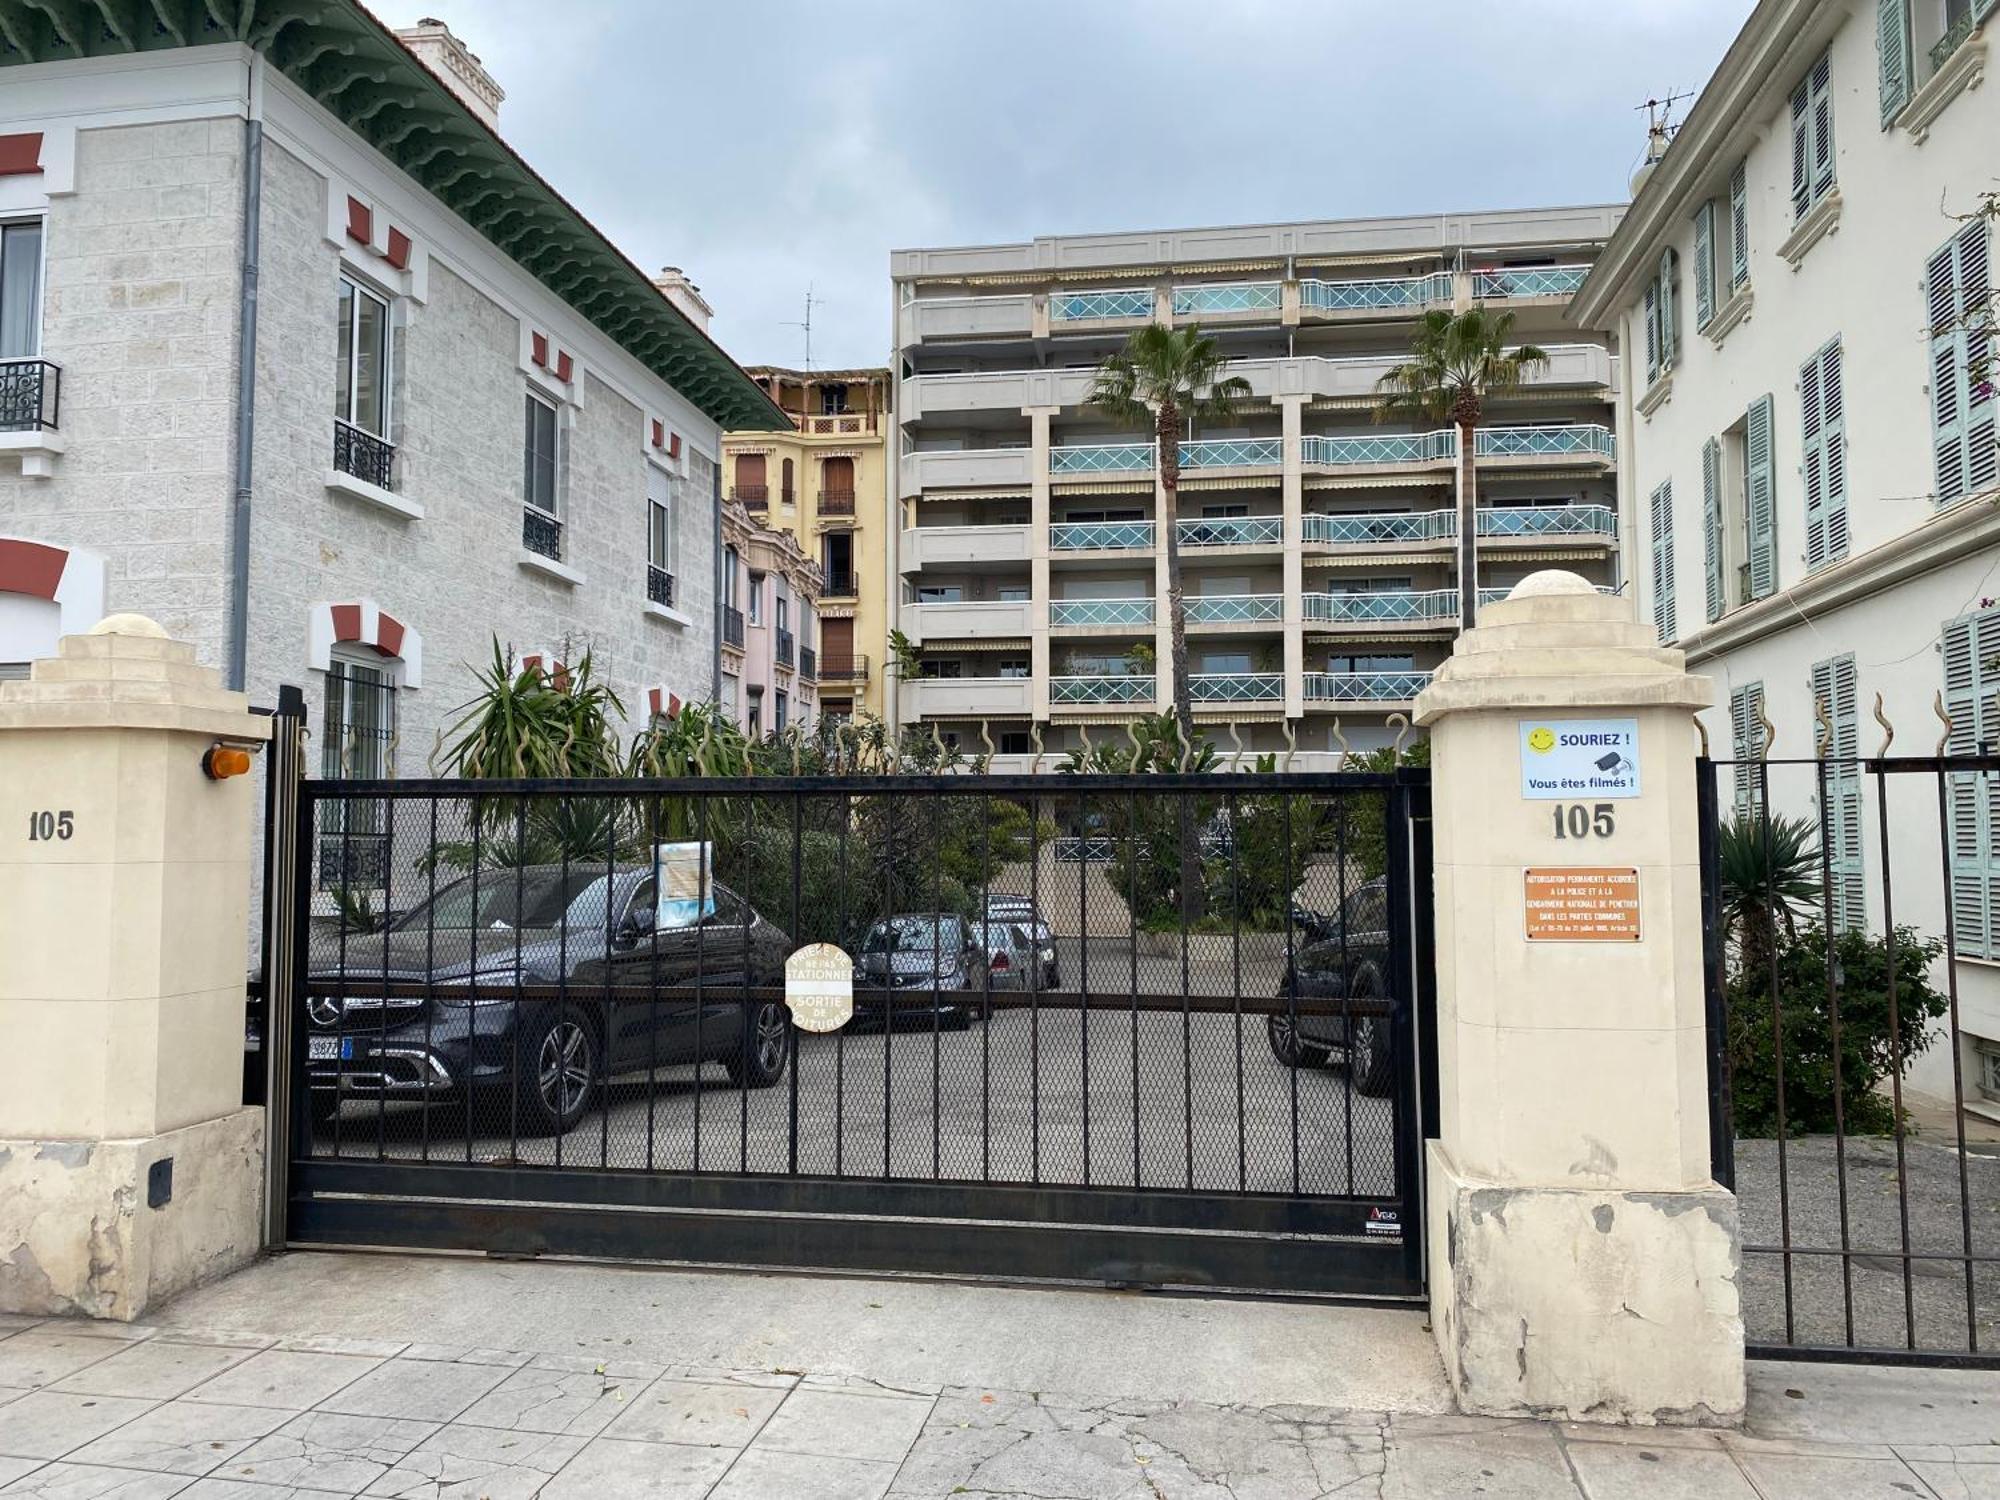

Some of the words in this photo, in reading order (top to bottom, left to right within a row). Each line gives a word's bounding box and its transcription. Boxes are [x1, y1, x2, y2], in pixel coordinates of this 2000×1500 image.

[1560, 734, 1620, 746] SOURIEZ
[1626, 733, 1630, 745] !
[1529, 779, 1558, 789] Vous
[1560, 778, 1586, 788] êtes
[1589, 777, 1626, 788] filmés
[28, 810, 74, 841] 105
[1553, 803, 1615, 839] 105
[1556, 887, 1565, 896] LA
[1567, 887, 1587, 896] POLICE
[1588, 887, 1597, 896] ET
[1604, 887, 1613, 896] LA
[1539, 912, 1555, 921] DANS
[1556, 912, 1568, 921] LES
[798, 996, 841, 1007] SORTIE
[814, 1009, 826, 1017] DE
